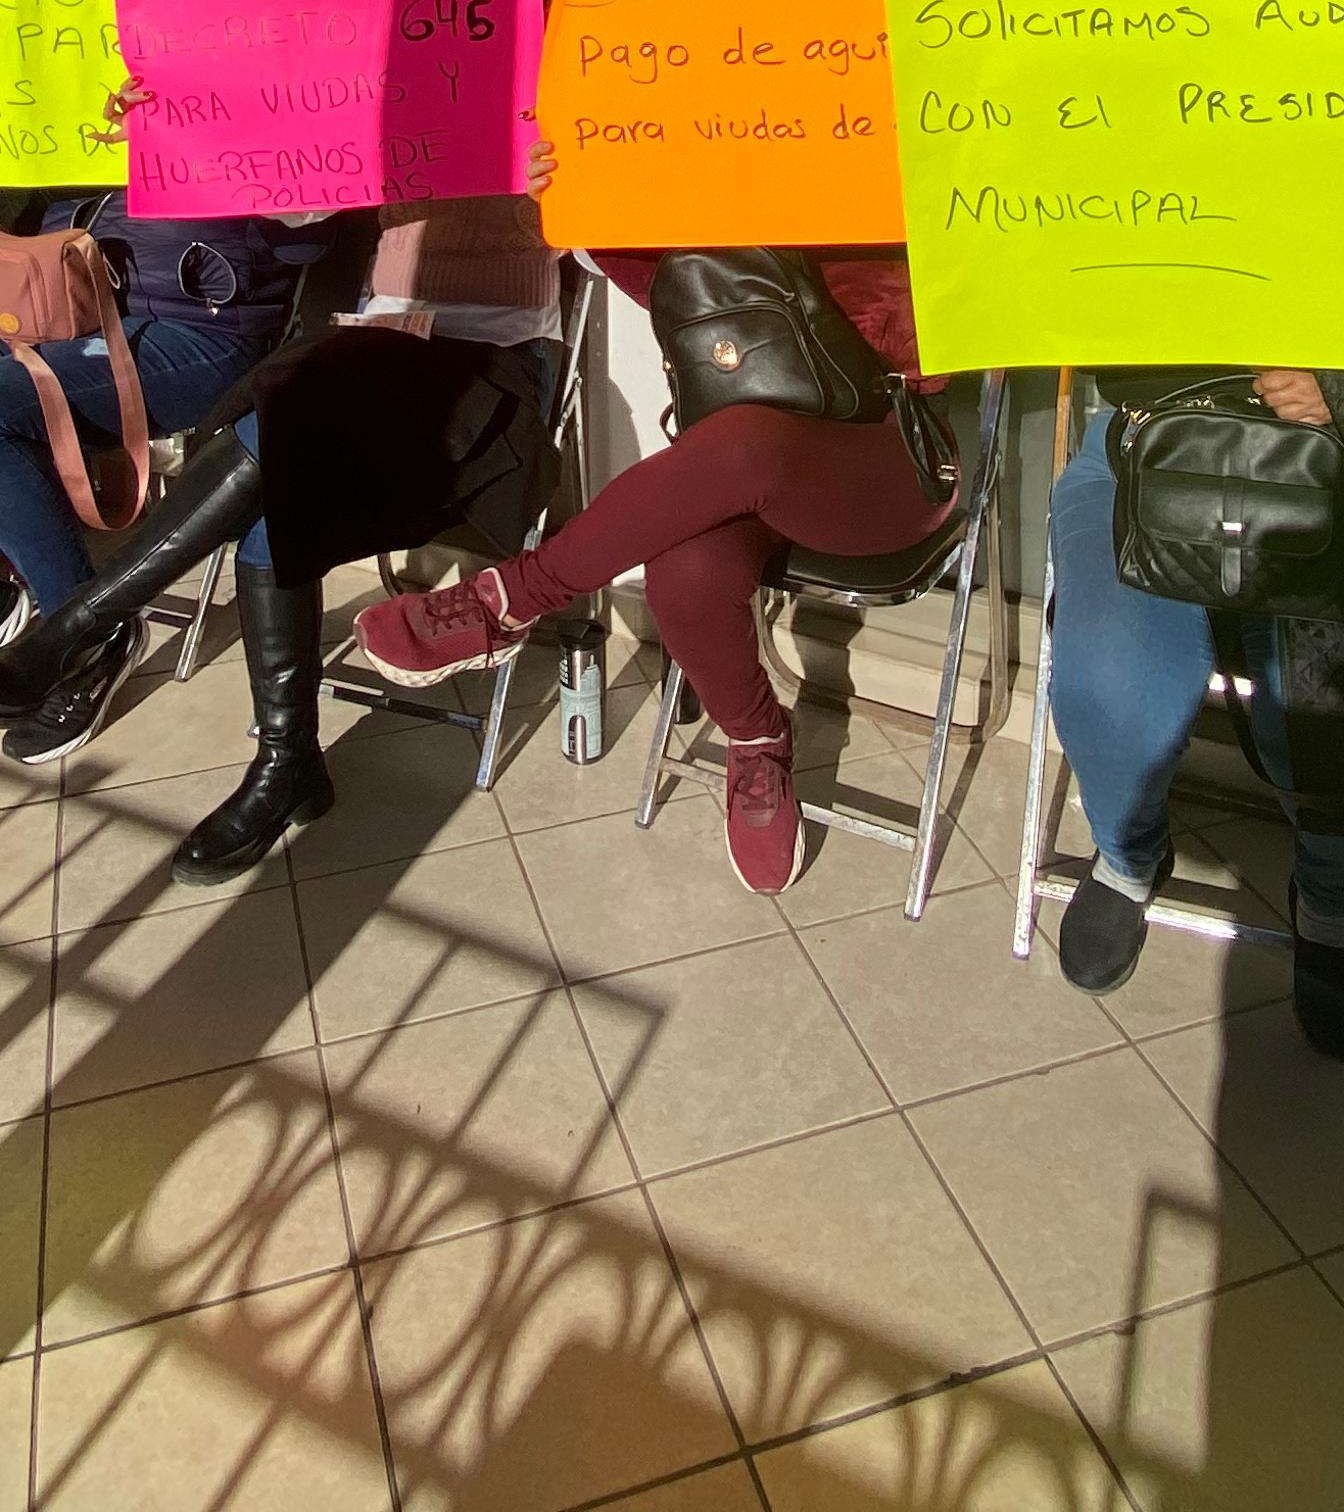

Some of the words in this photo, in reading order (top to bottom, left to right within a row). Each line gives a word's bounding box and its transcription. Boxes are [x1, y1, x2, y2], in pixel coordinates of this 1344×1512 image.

[128, 11, 359, 61] DECRETO
[723, 26, 787, 65] de
[138, 90, 231, 131] PARA
[260, 68, 408, 115] VIUDAS
[438, 59, 460, 105] Y
[919, 89, 1012, 134] CON
[693, 108, 806, 141] viudas
[832, 103, 875, 141] de
[138, 141, 364, 193] HUERFANOS
[379, 128, 454, 170] DE
[232, 172, 435, 210] POLICIAS
[945, 184, 1238, 233] MUNICIPAL
